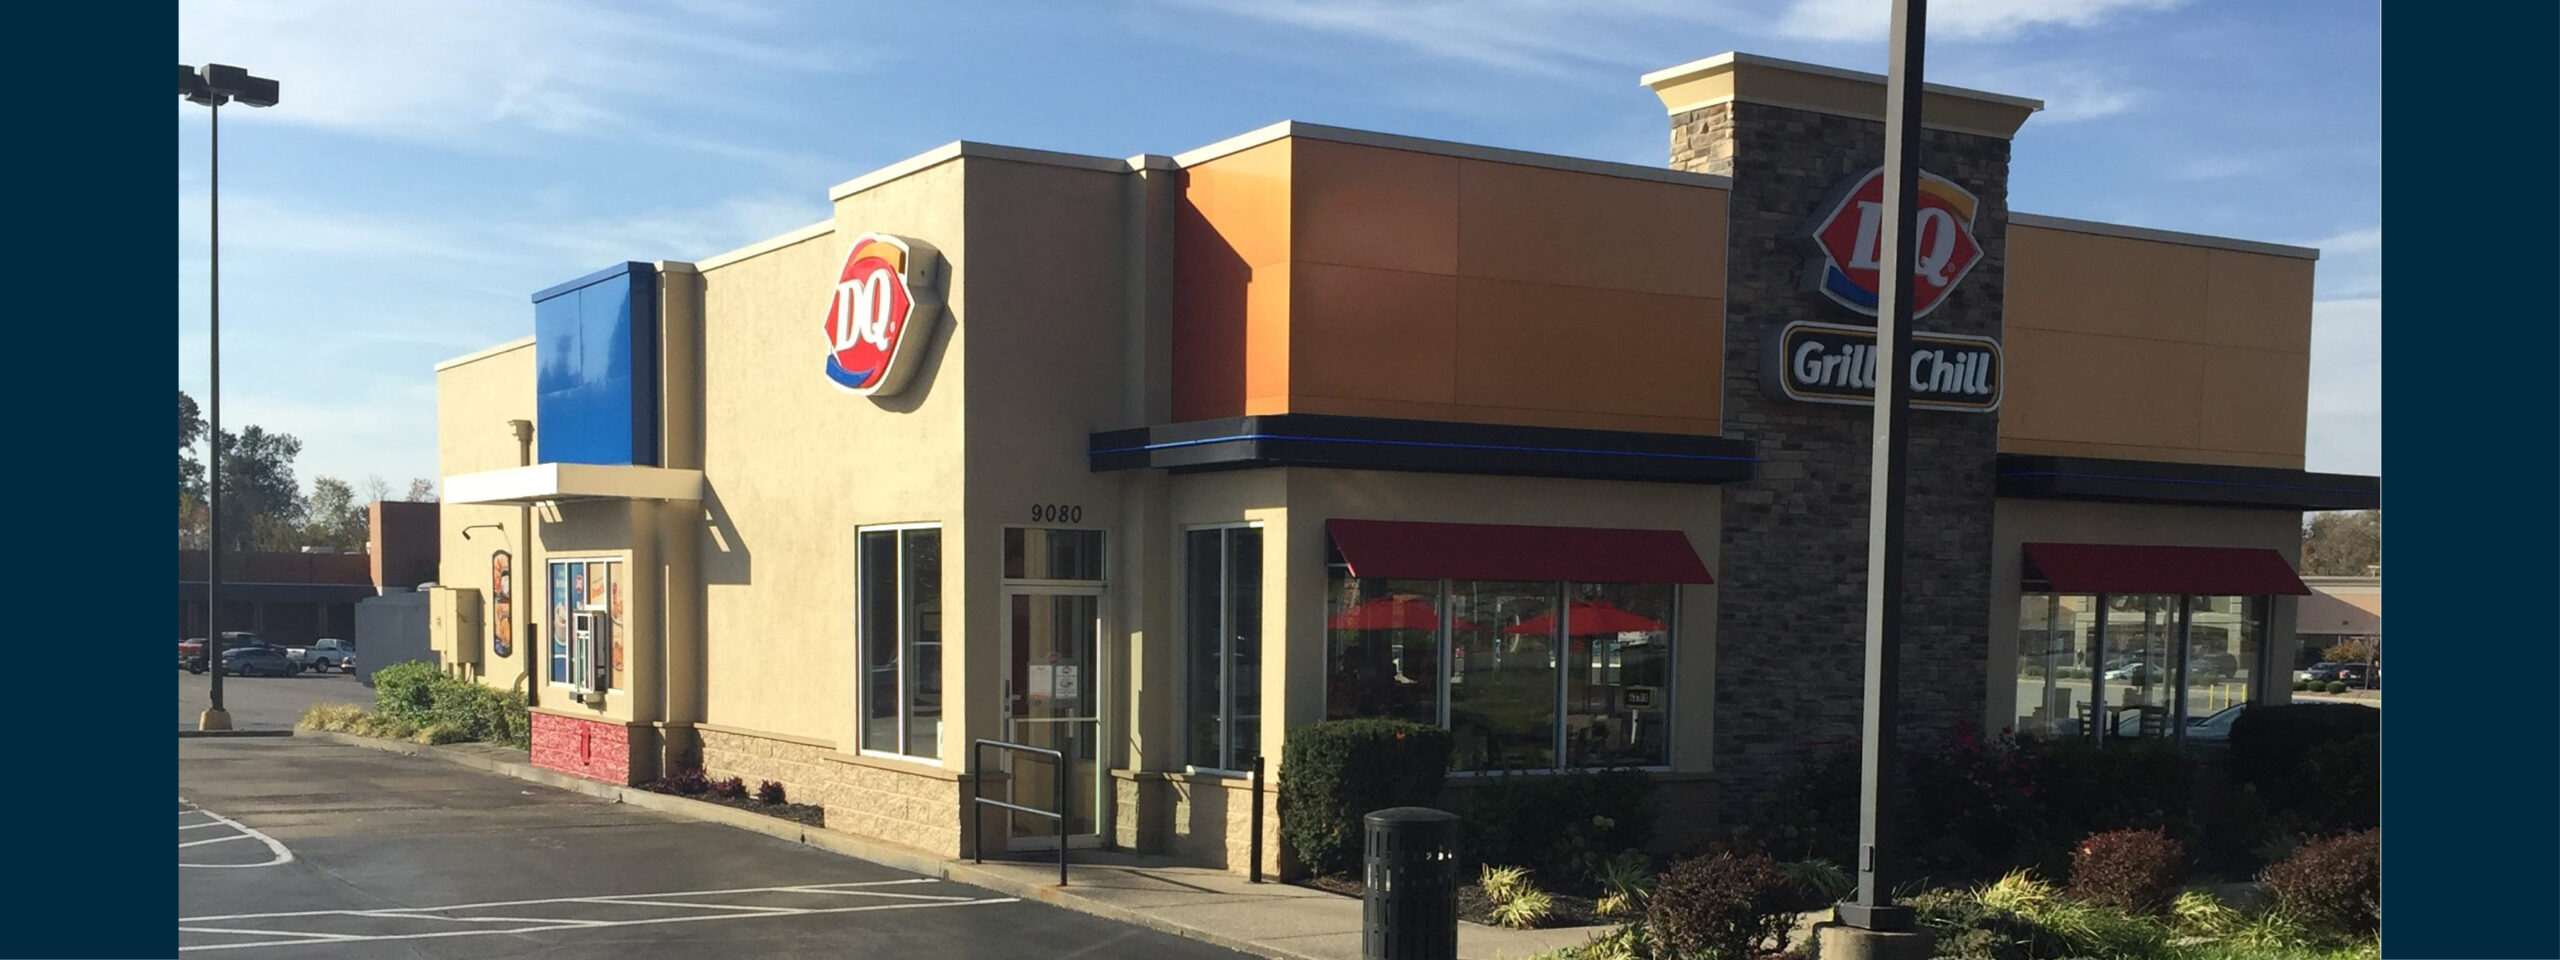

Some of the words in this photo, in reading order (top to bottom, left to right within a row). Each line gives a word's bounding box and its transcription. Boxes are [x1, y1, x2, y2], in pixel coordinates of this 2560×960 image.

[835, 268, 892, 352] DQ
[1793, 340, 1878, 389] Grill
[1910, 349, 1992, 395] Chill
[1031, 503, 1082, 524] 9080
